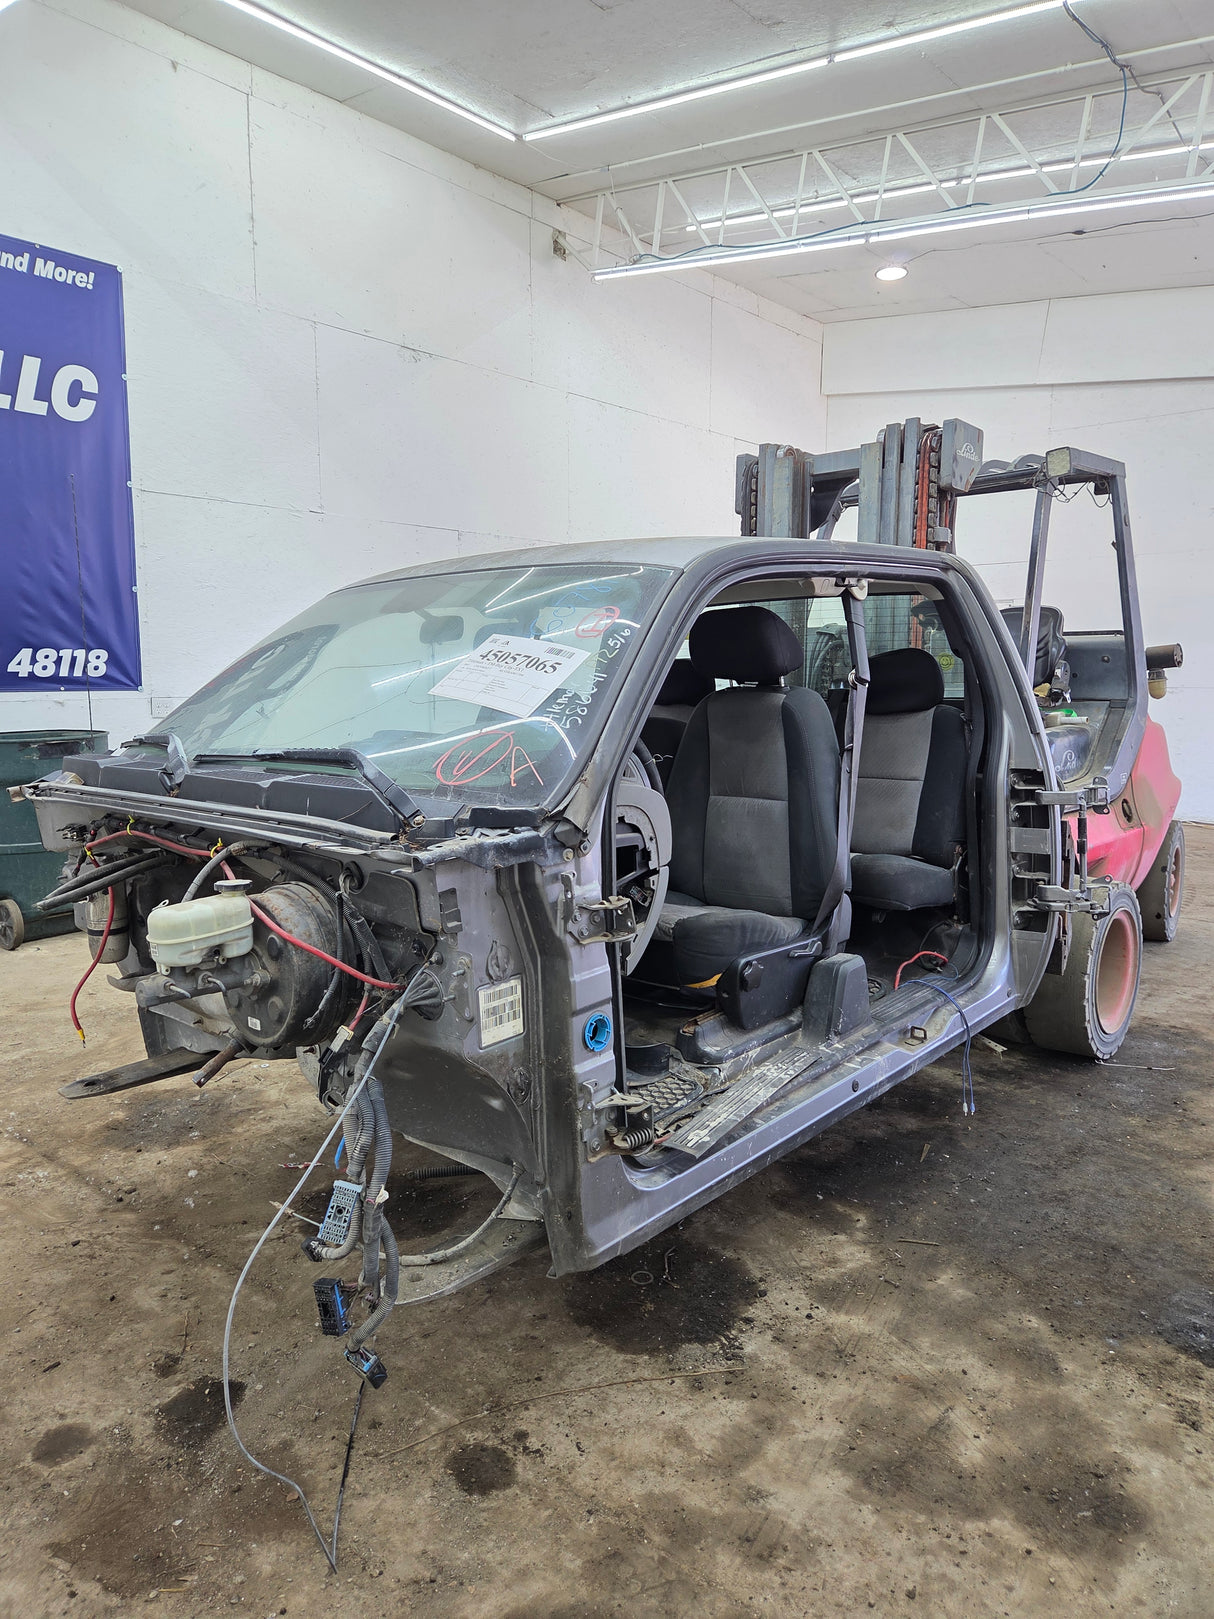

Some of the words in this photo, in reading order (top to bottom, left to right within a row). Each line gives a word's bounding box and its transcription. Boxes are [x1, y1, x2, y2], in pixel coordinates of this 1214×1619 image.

[0, 251, 30, 273] nd
[33, 257, 95, 290] More!
[7, 648, 109, 677] 48118
[479, 649, 562, 674] 45057065
